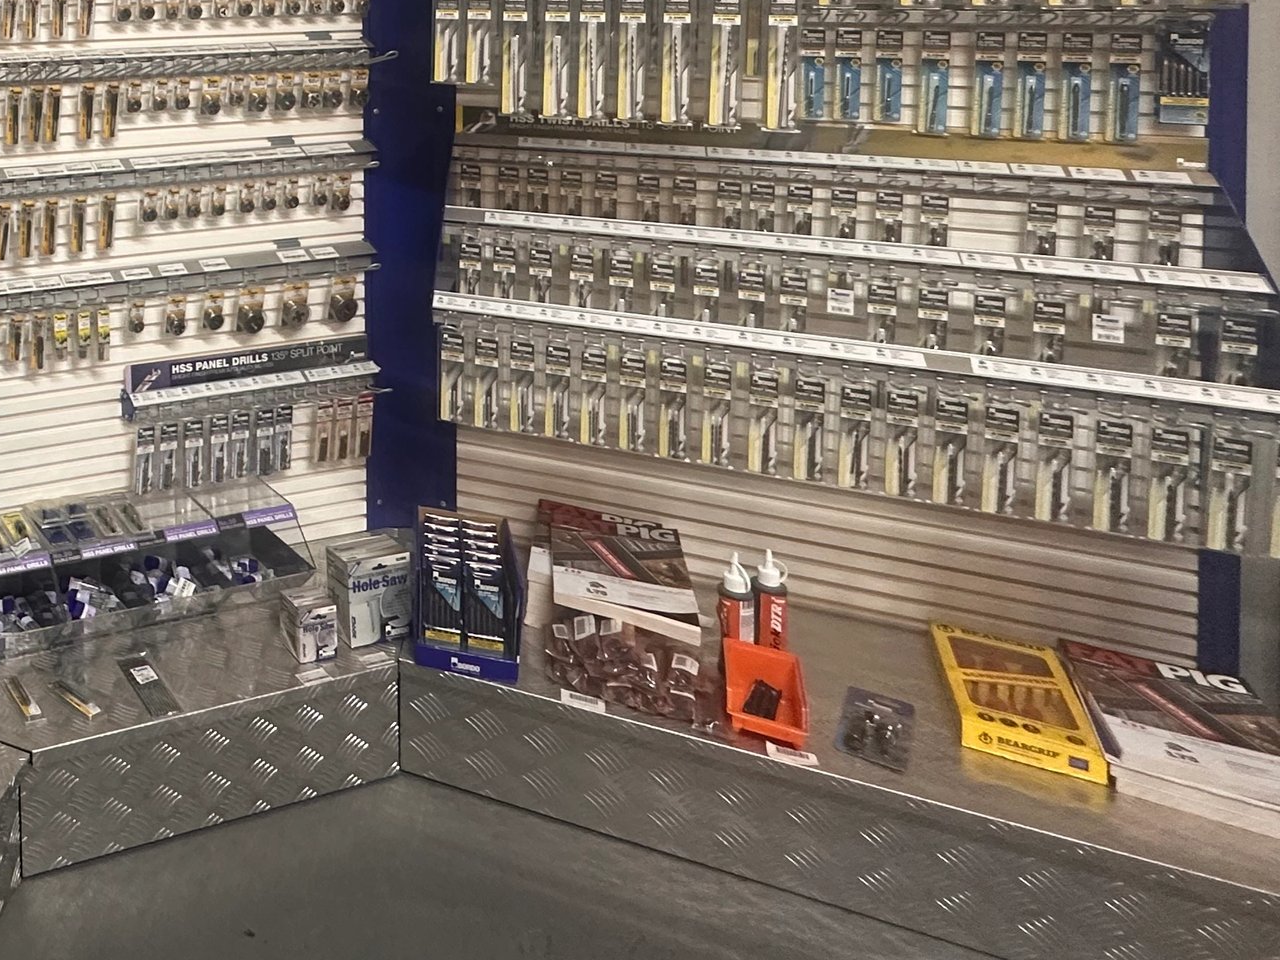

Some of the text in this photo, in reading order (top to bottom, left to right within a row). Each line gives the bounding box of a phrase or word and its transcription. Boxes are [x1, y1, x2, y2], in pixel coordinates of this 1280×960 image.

[172, 364, 193, 374] HSS
[196, 358, 230, 371] PANEL
[232, 353, 268, 366] DRILLS
[617, 523, 676, 542] PIG
[352, 573, 408, 593] Hole Saw
[1155, 663, 1248, 694] PIG
[996, 736, 1061, 759] BEARGRIP
